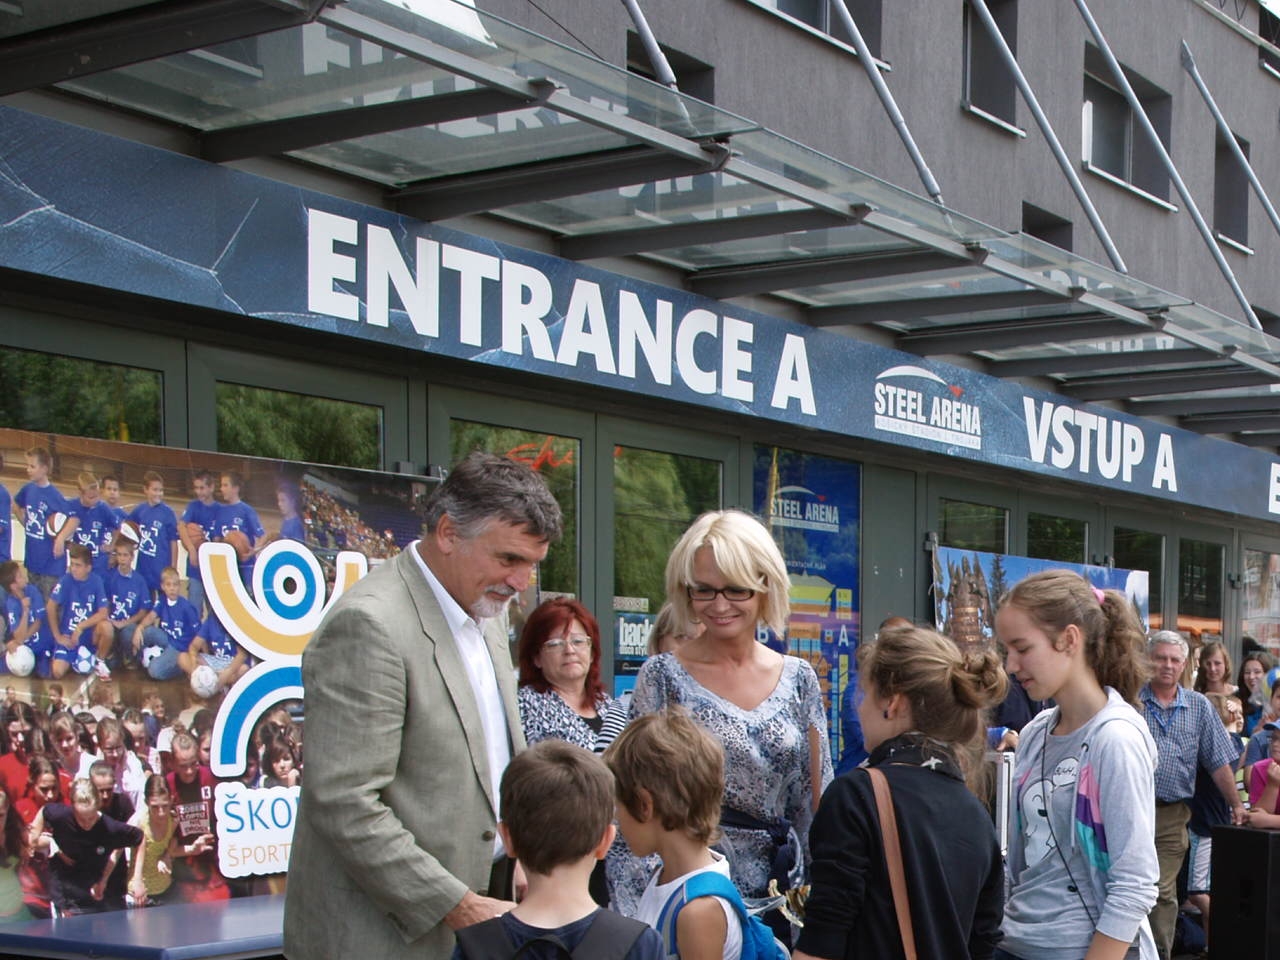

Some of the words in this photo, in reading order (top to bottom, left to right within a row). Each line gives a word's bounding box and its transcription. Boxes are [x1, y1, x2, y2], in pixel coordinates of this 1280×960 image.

[308, 208, 754, 402] ENTRANCE
[770, 333, 817, 416] A
[874, 382, 927, 423] STEEL
[929, 396, 981, 436] ARENA
[1023, 396, 1145, 482] VSTUP
[1152, 433, 1178, 493] A
[770, 498, 803, 520] STEEL
[804, 502, 840, 524] ARENA
[757, 621, 769, 644] B
[838, 624, 849, 647] A
[224, 793, 301, 833] ŠKO
